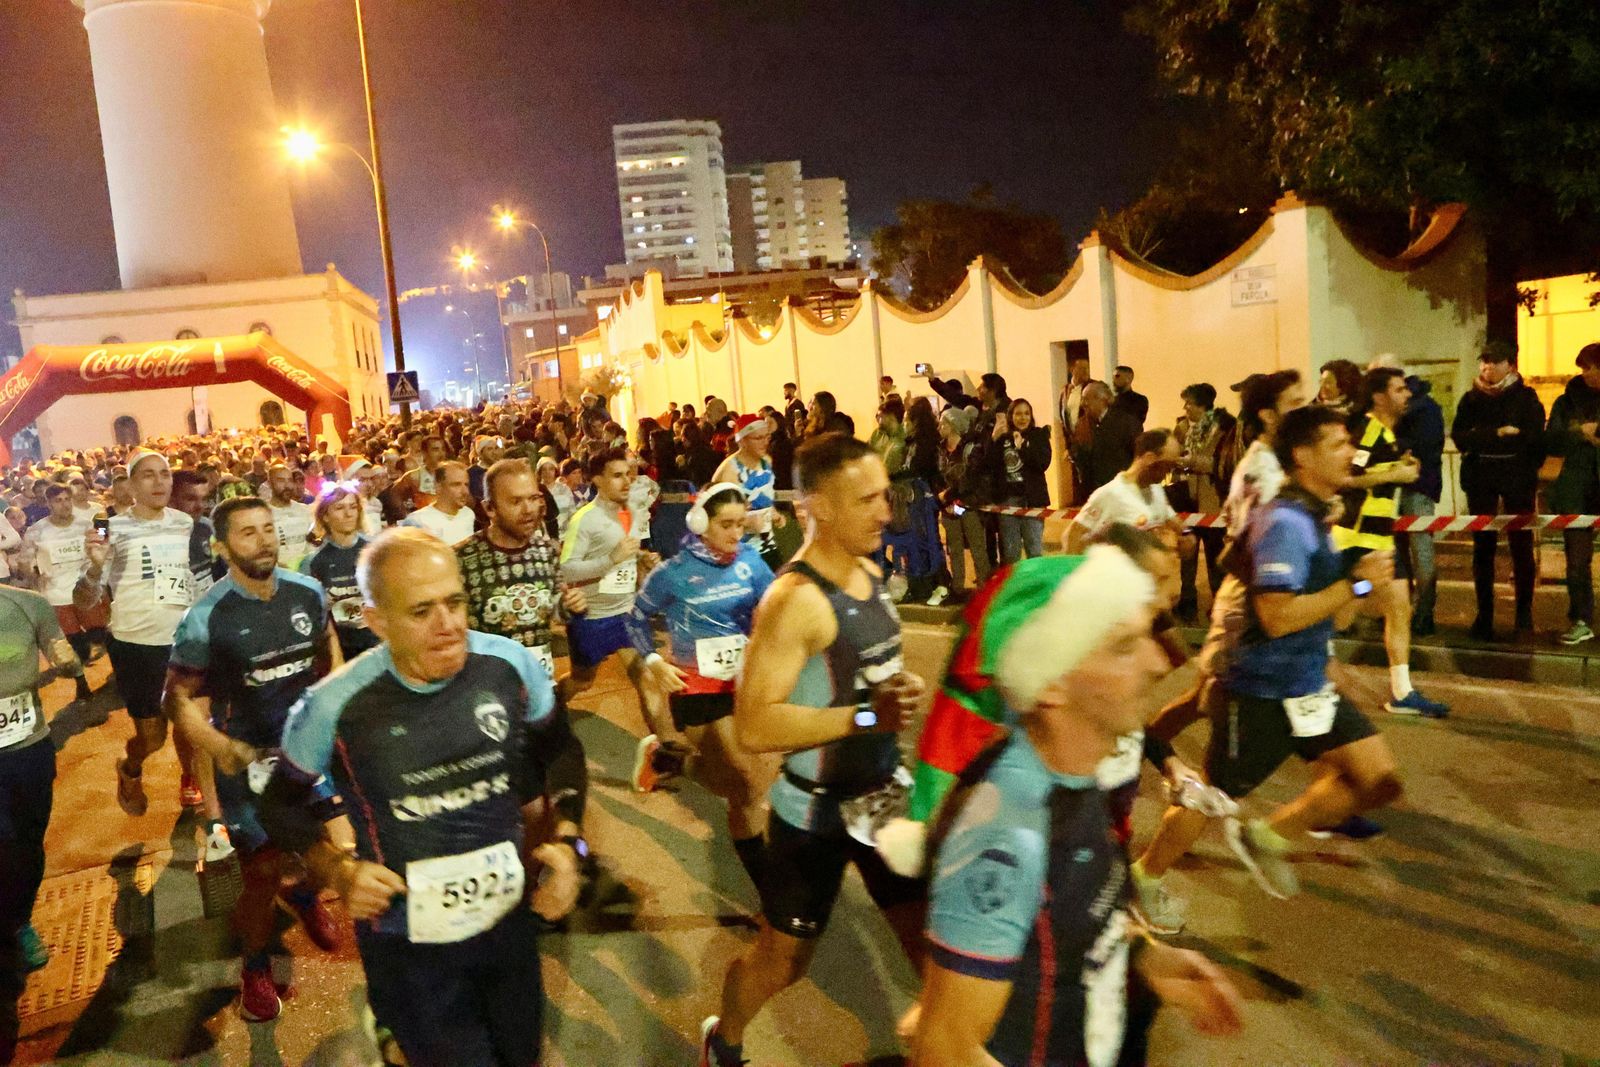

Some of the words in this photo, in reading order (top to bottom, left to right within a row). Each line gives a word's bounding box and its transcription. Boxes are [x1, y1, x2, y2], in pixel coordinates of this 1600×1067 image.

[79, 343, 197, 381] Coca-Cola
[267, 356, 316, 389] Coca-Cola
[714, 647, 742, 664] 427
